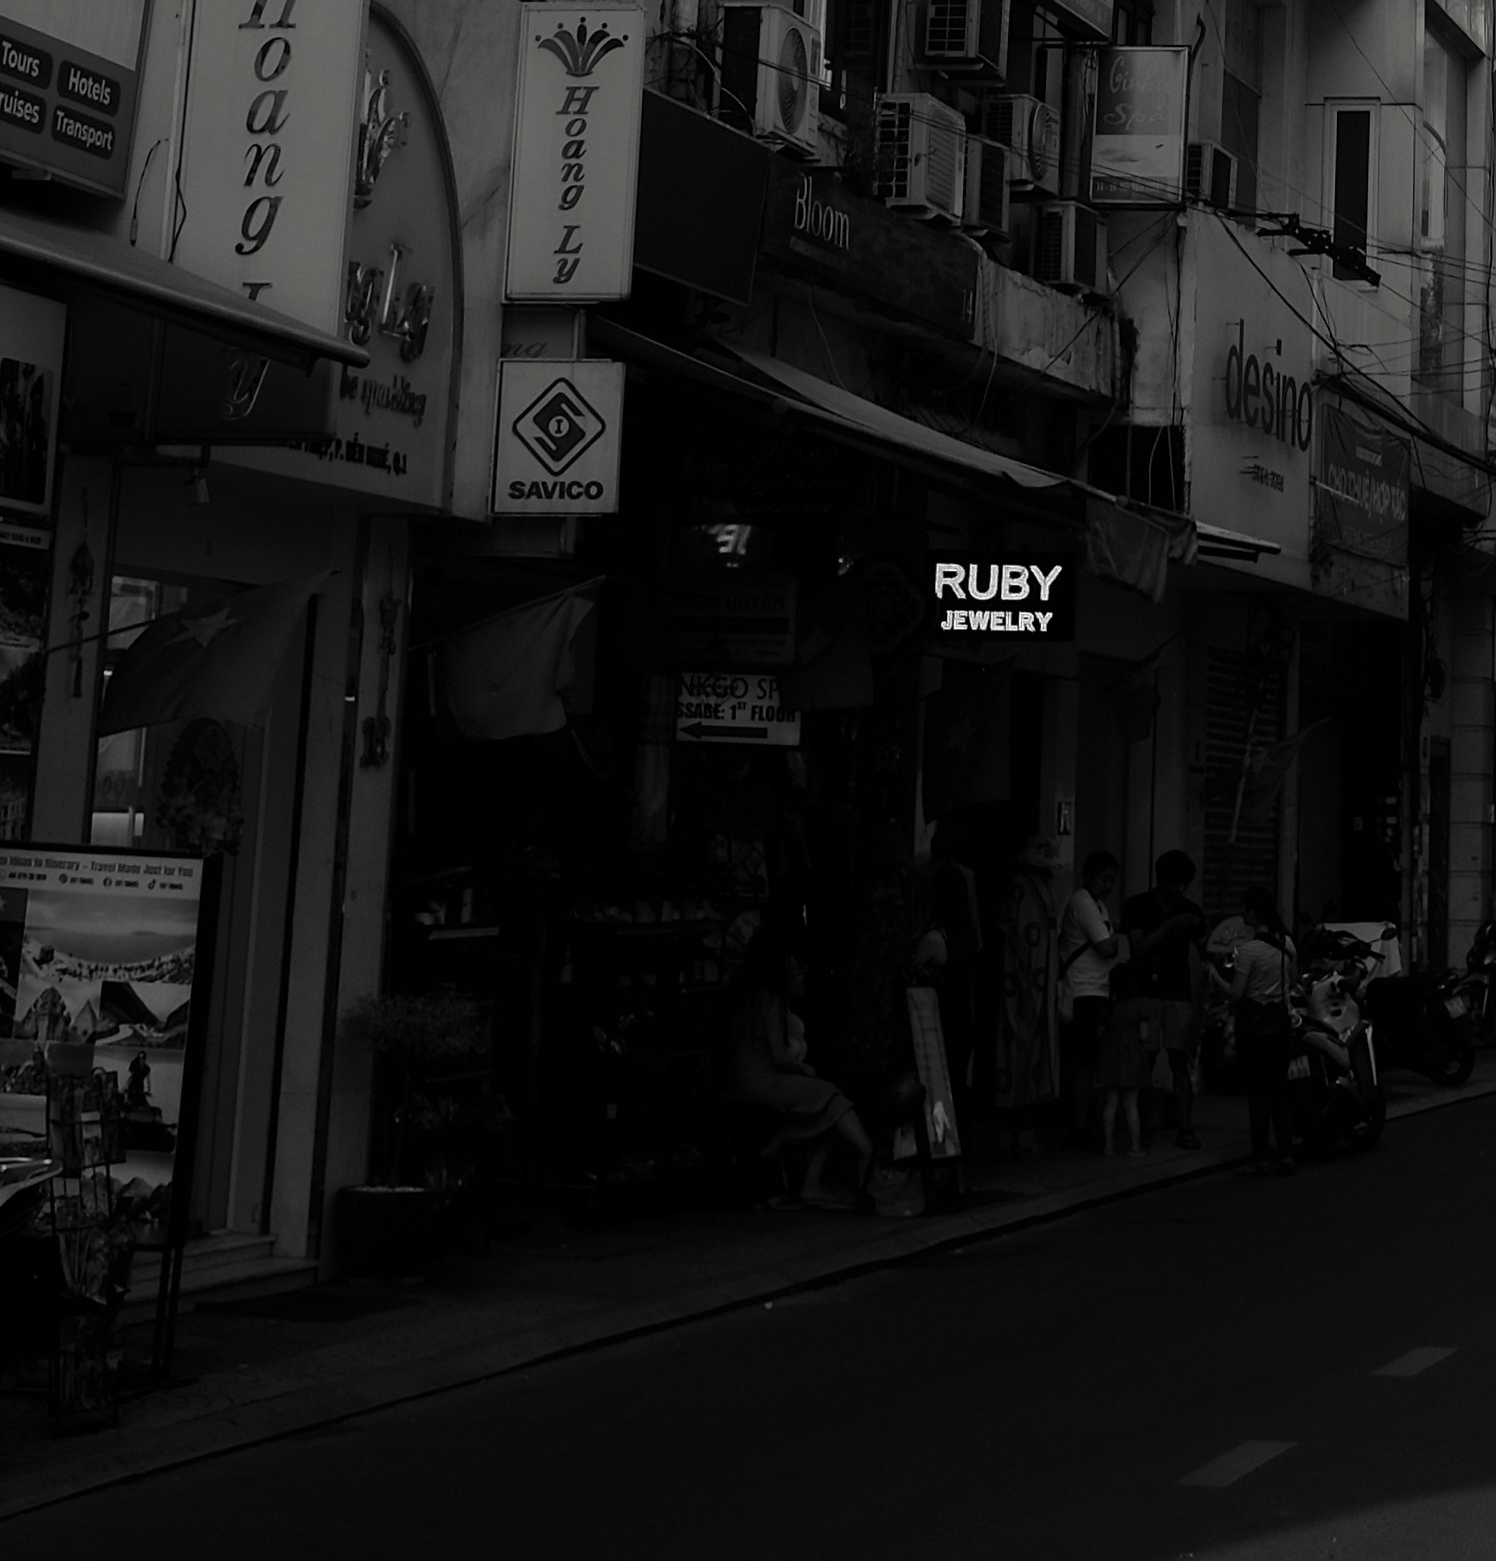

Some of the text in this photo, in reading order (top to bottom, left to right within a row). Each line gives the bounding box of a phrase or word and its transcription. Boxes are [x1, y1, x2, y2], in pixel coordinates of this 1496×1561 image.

[1, 41, 41, 78] Tours
[68, 67, 112, 106] Hotels
[56, 109, 114, 151] Transport
[556, 86, 600, 211] Hoang
[793, 172, 850, 252] Bloom
[553, 225, 583, 284] Ly
[1225, 318, 1313, 452] desino
[508, 480, 604, 500] SAVICO
[934, 563, 1063, 601] RUBY
[940, 610, 1054, 633] JEWELRY
